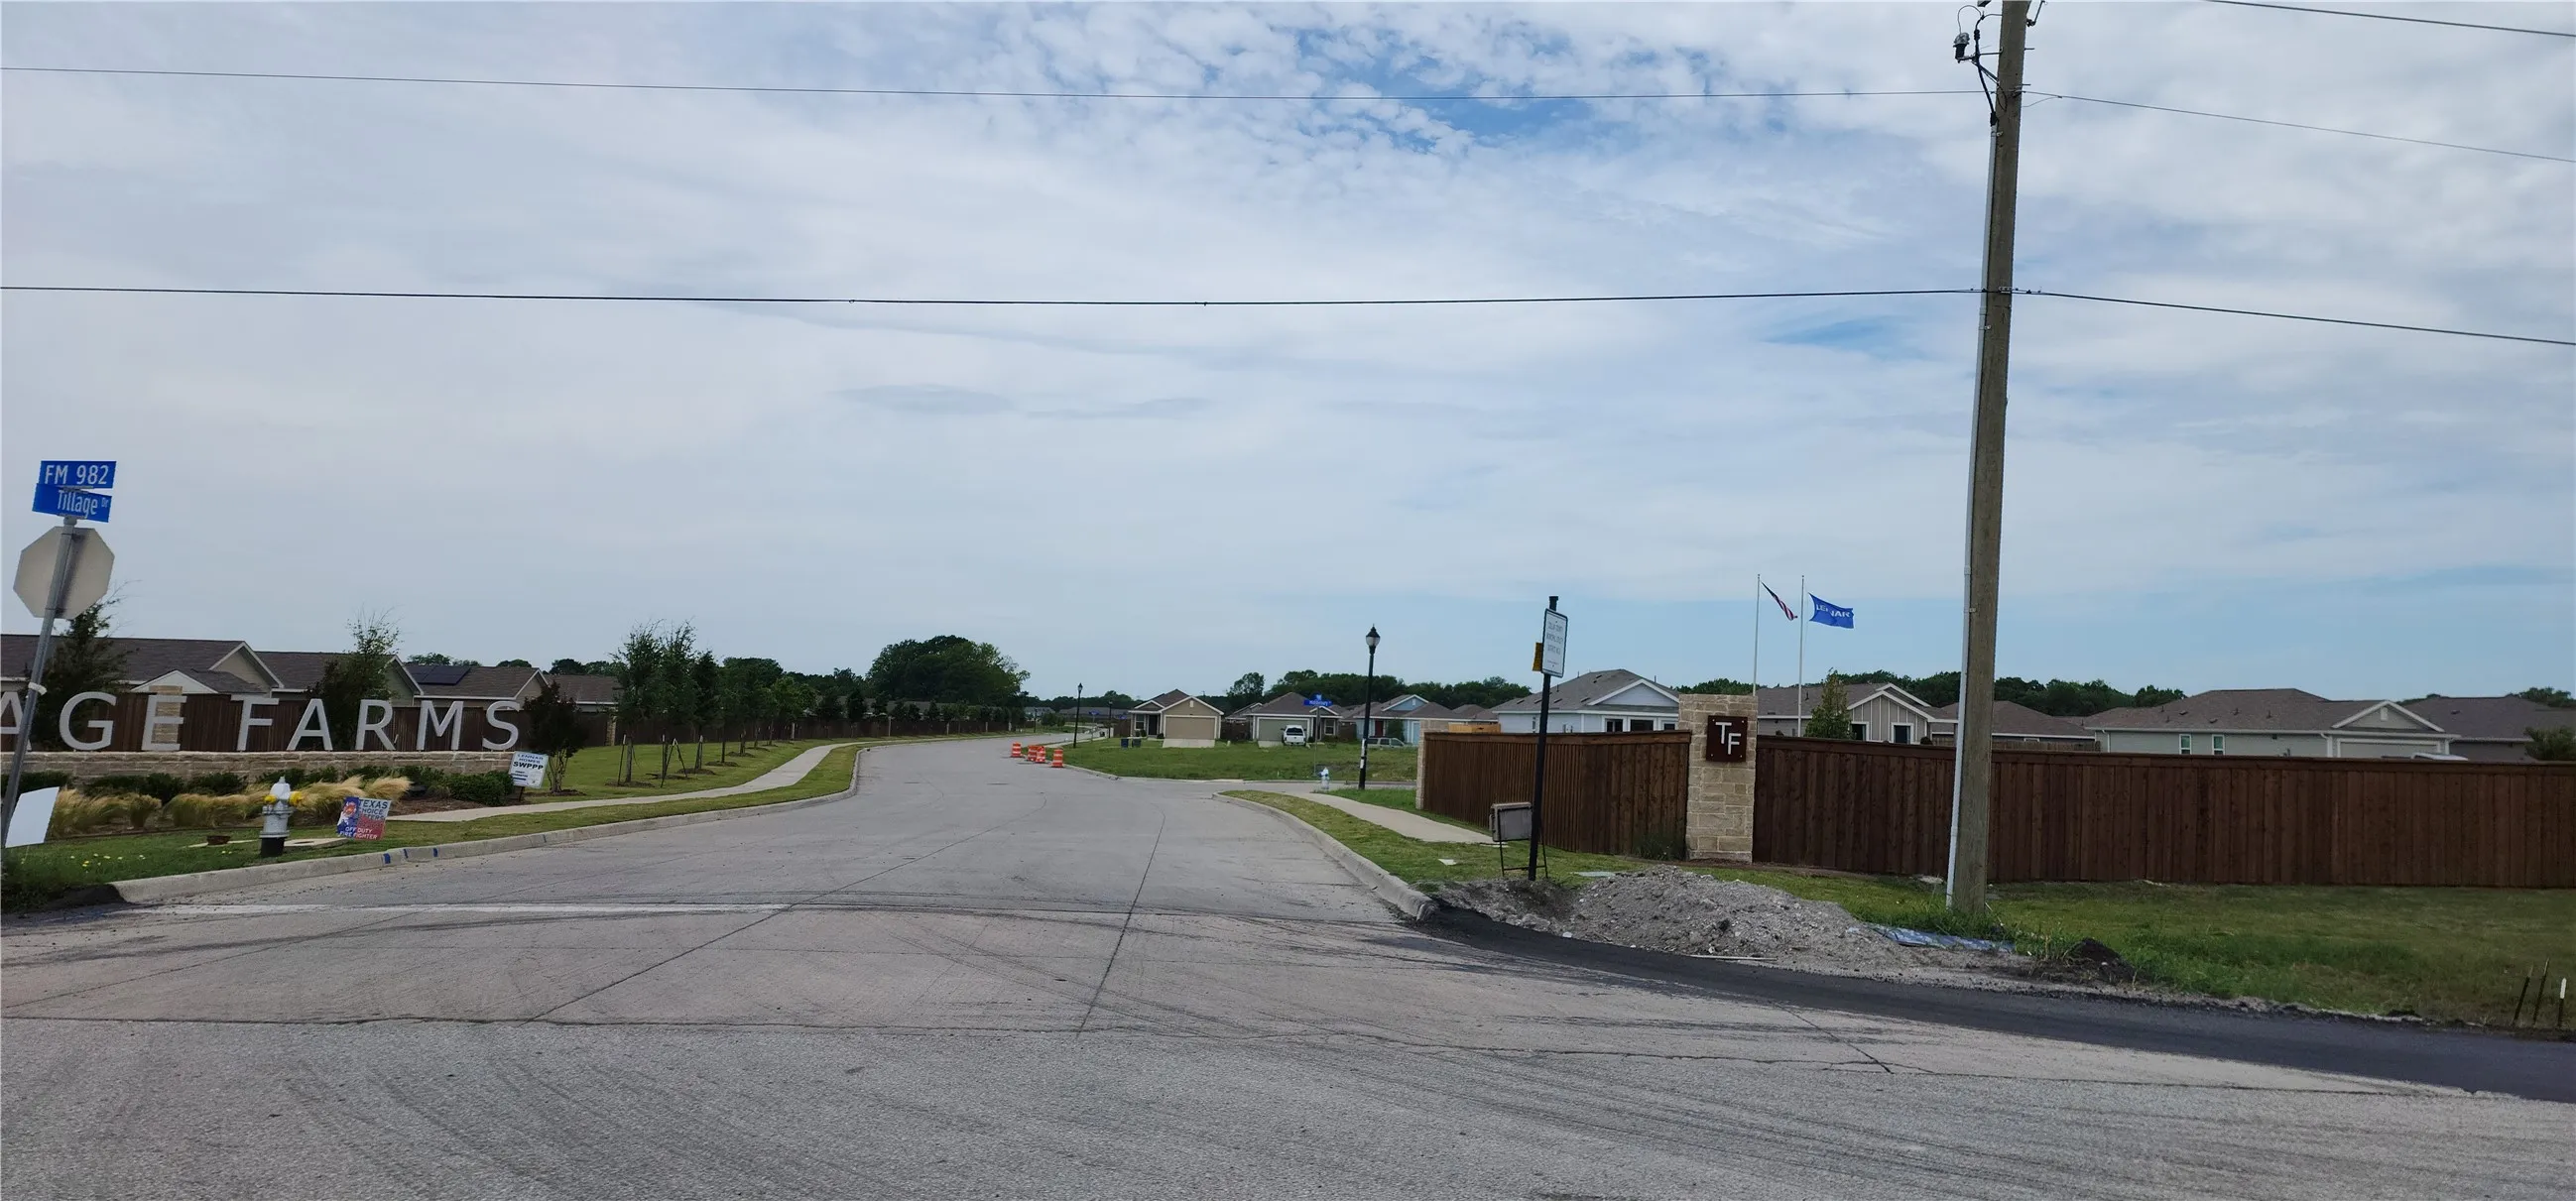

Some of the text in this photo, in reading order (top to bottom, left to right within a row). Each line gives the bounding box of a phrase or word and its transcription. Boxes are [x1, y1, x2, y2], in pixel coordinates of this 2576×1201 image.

[45, 464, 109, 485] FM 982
[57, 489, 98, 519] Tillage
[230, 697, 521, 752] FARMS
[513, 761, 544, 770] SWPPP
[358, 799, 388, 809] TEXAS
